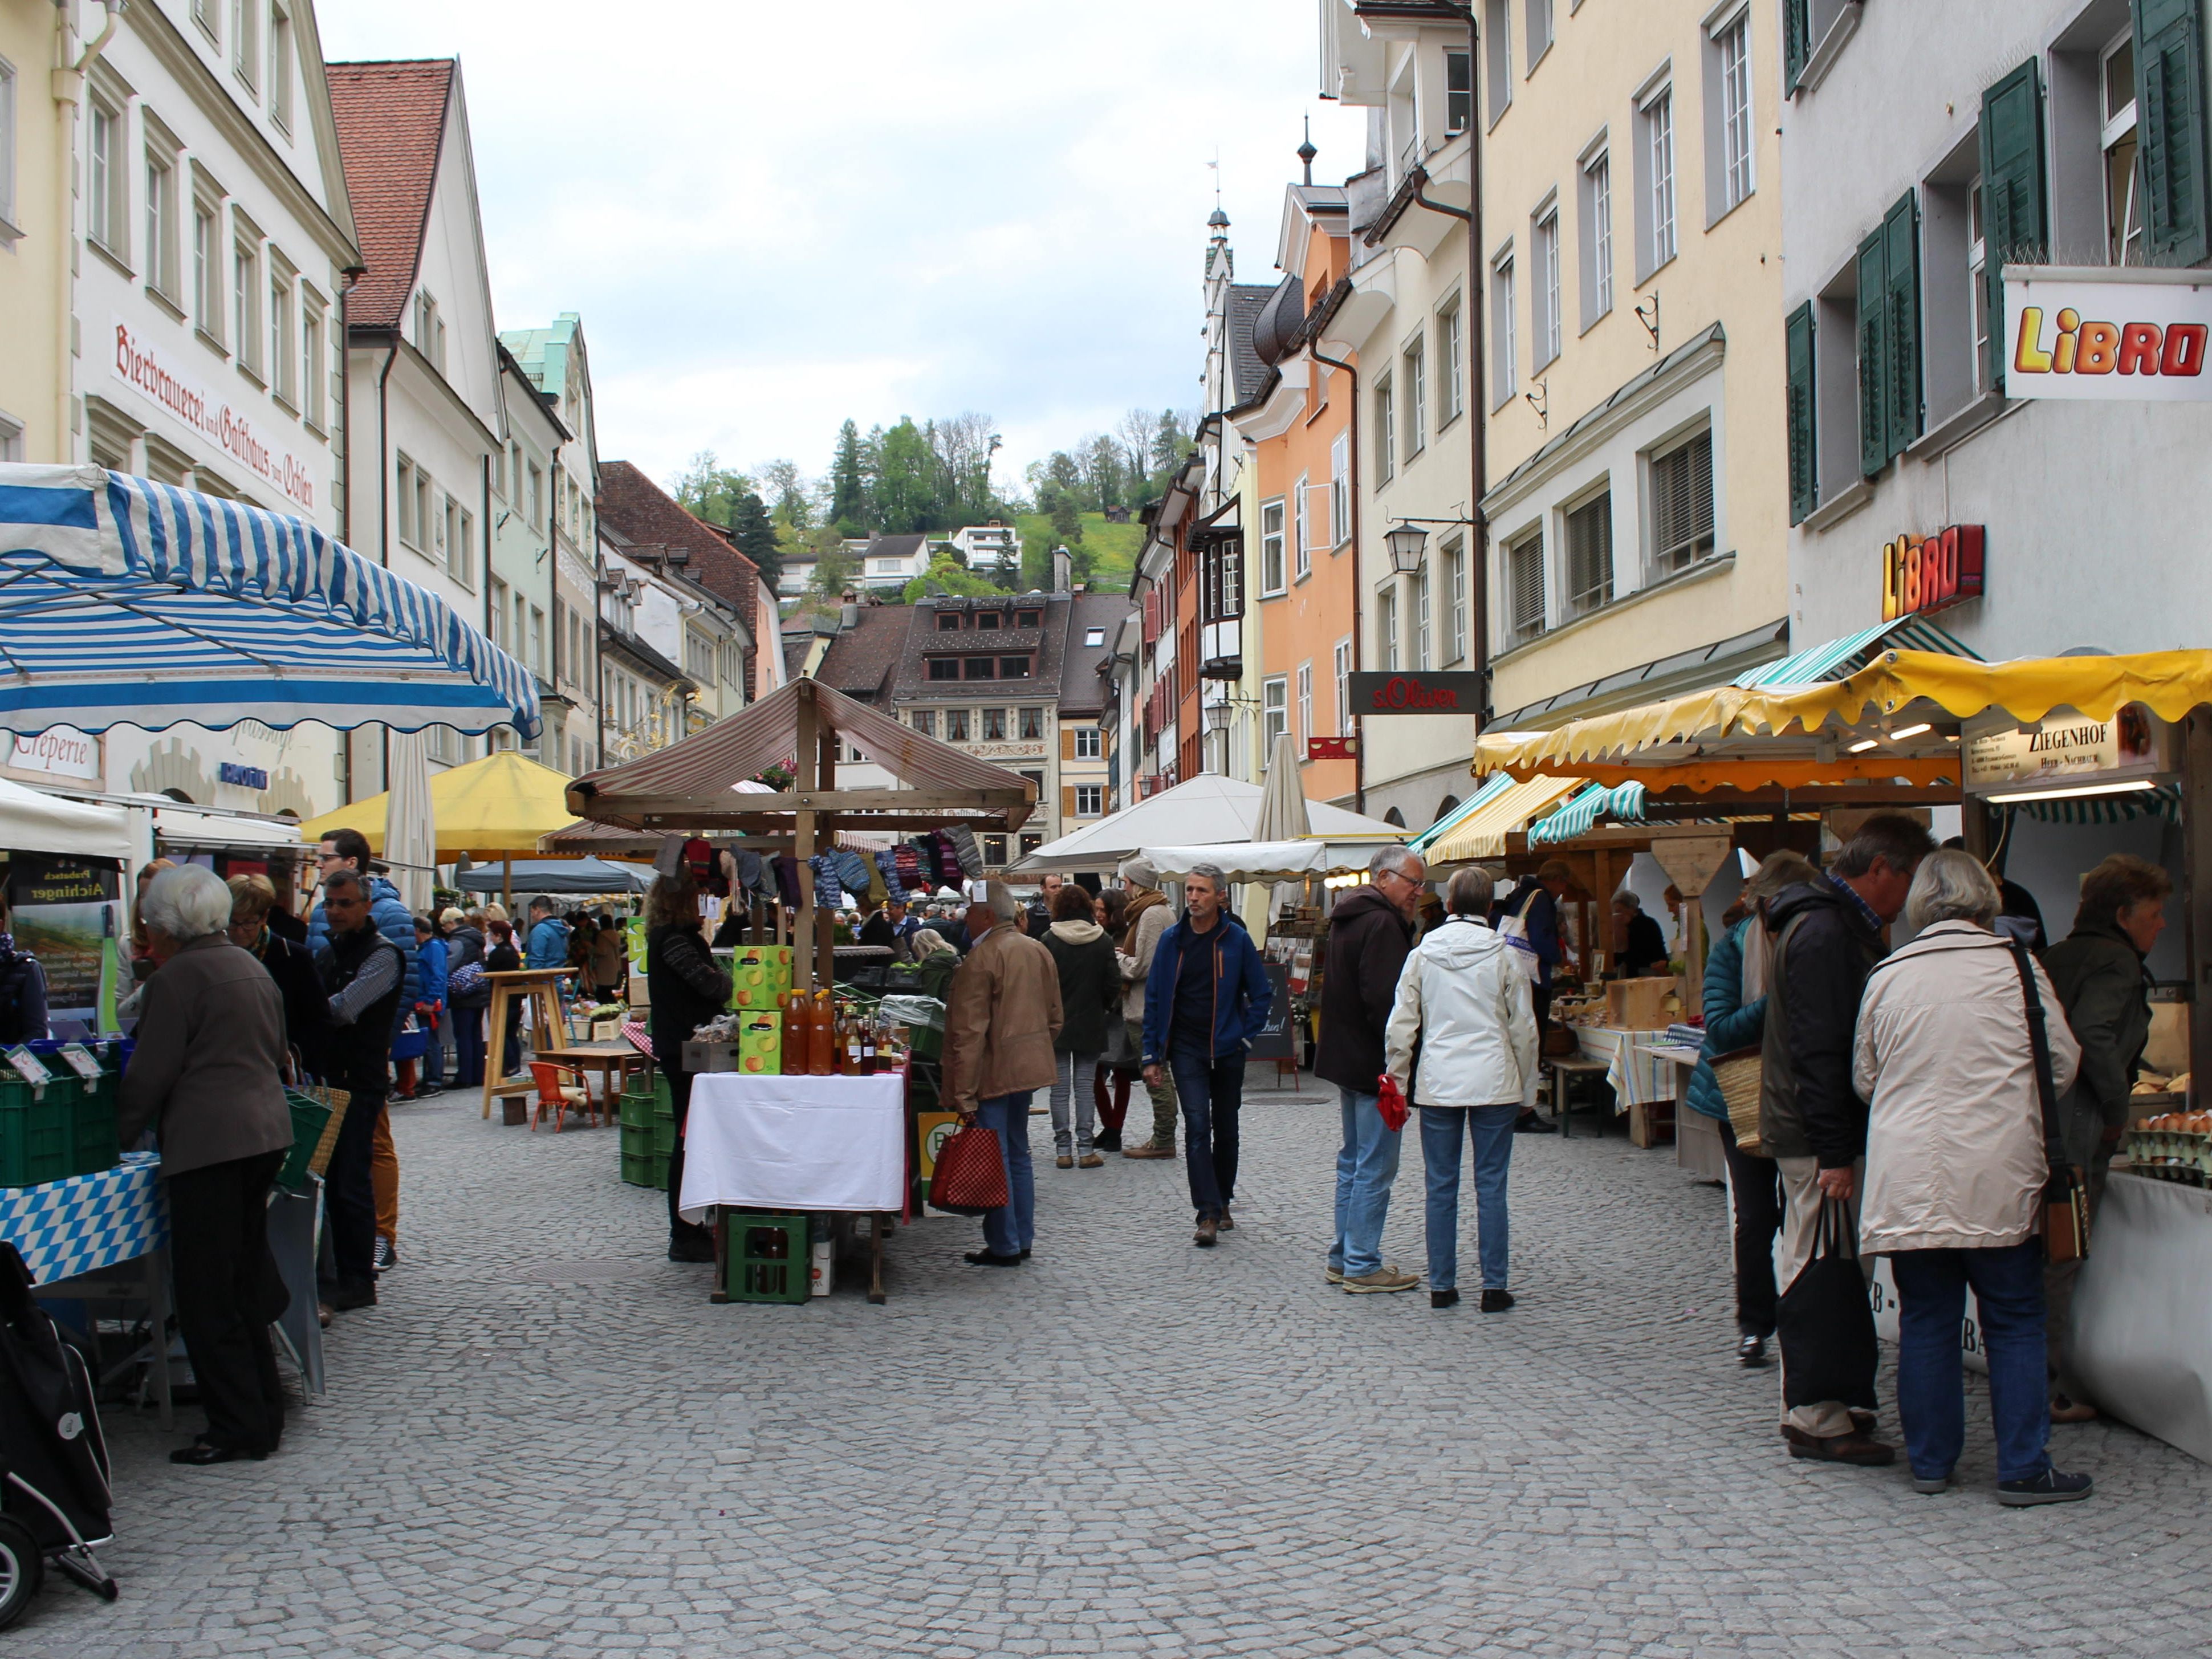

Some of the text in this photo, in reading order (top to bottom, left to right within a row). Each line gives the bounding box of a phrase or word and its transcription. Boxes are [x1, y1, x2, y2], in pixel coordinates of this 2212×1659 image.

[116, 323, 205, 431] Bierbrauerei
[1372, 676, 1459, 709] s.Oliver
[2029, 723, 2108, 753] ZIEGENHOF
